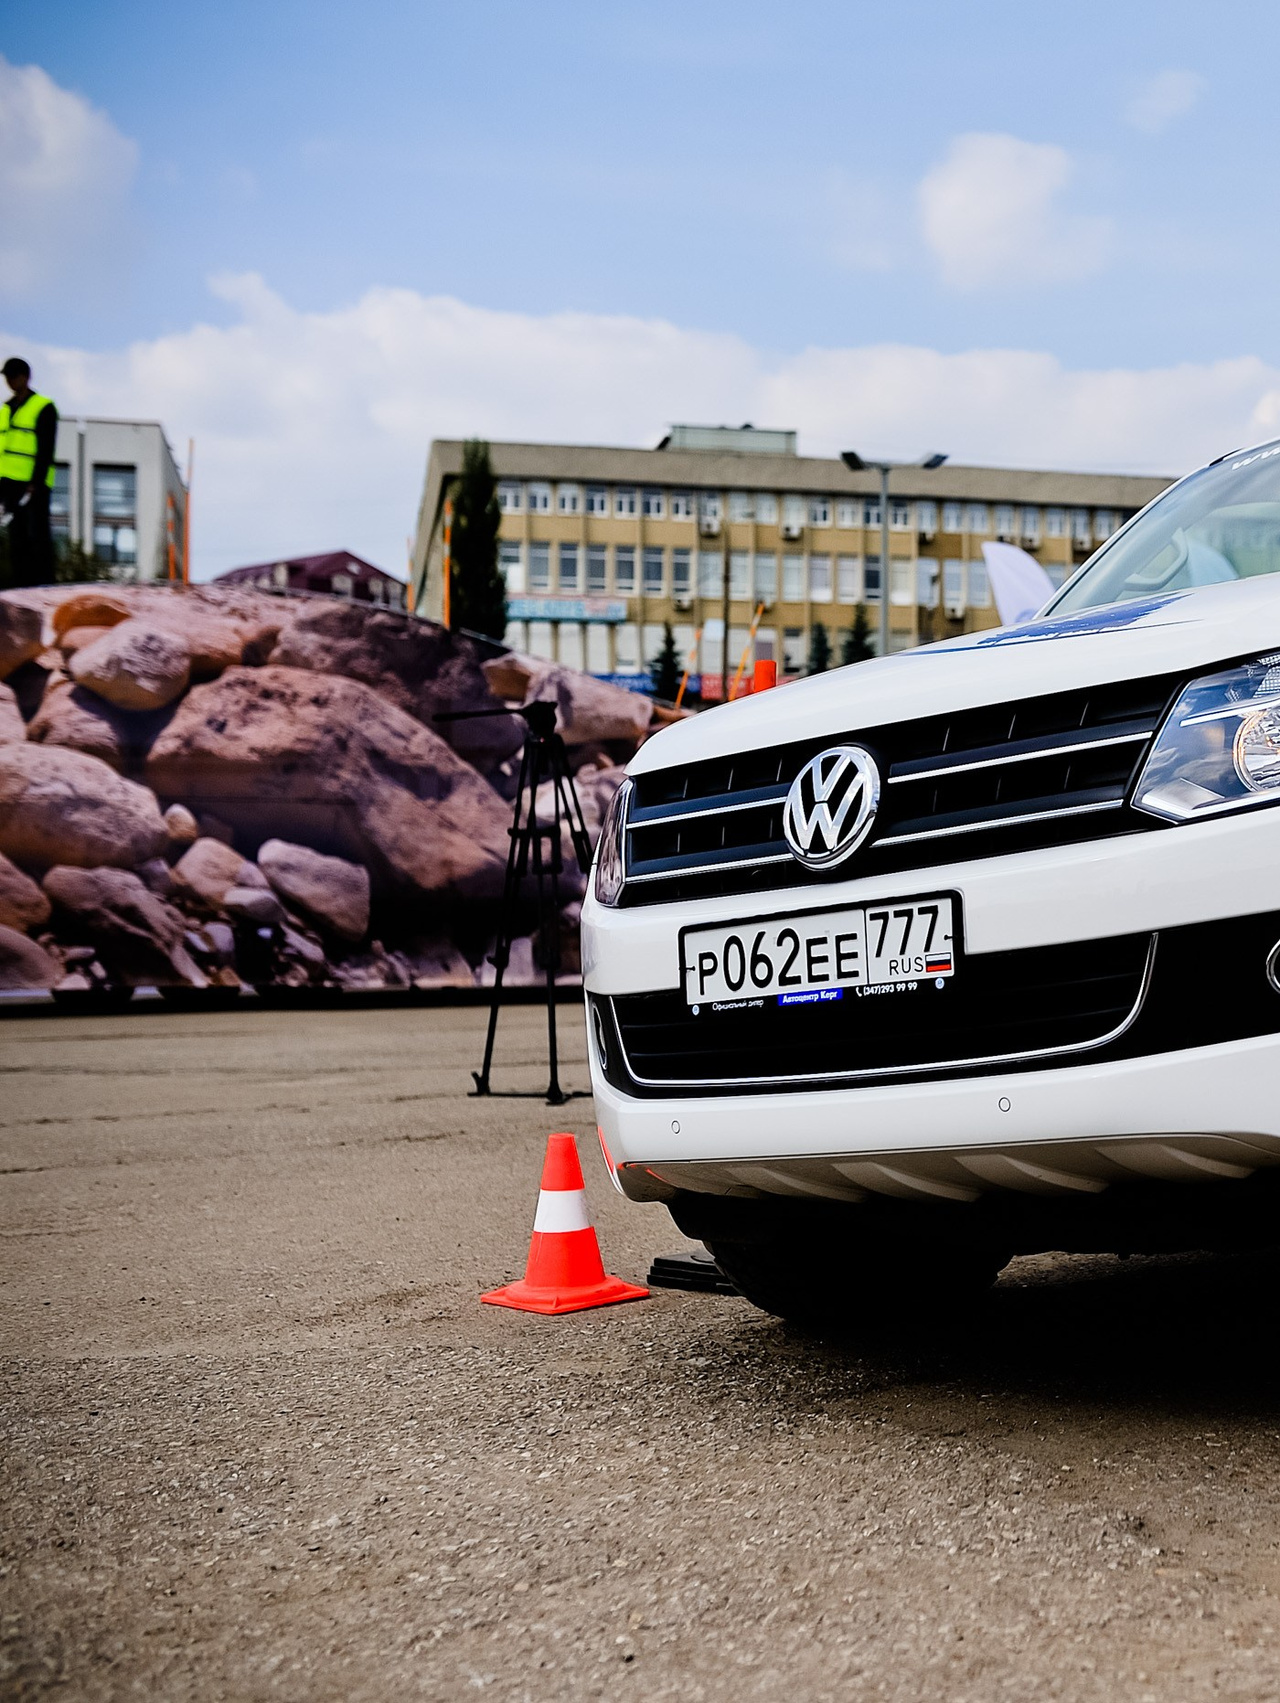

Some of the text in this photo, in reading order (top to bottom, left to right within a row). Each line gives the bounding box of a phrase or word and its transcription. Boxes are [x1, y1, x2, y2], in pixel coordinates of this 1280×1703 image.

[869, 904, 939, 958] 777
[889, 957, 924, 976] RUS
[896, 983, 906, 992] 99
[907, 982, 918, 991] 99
